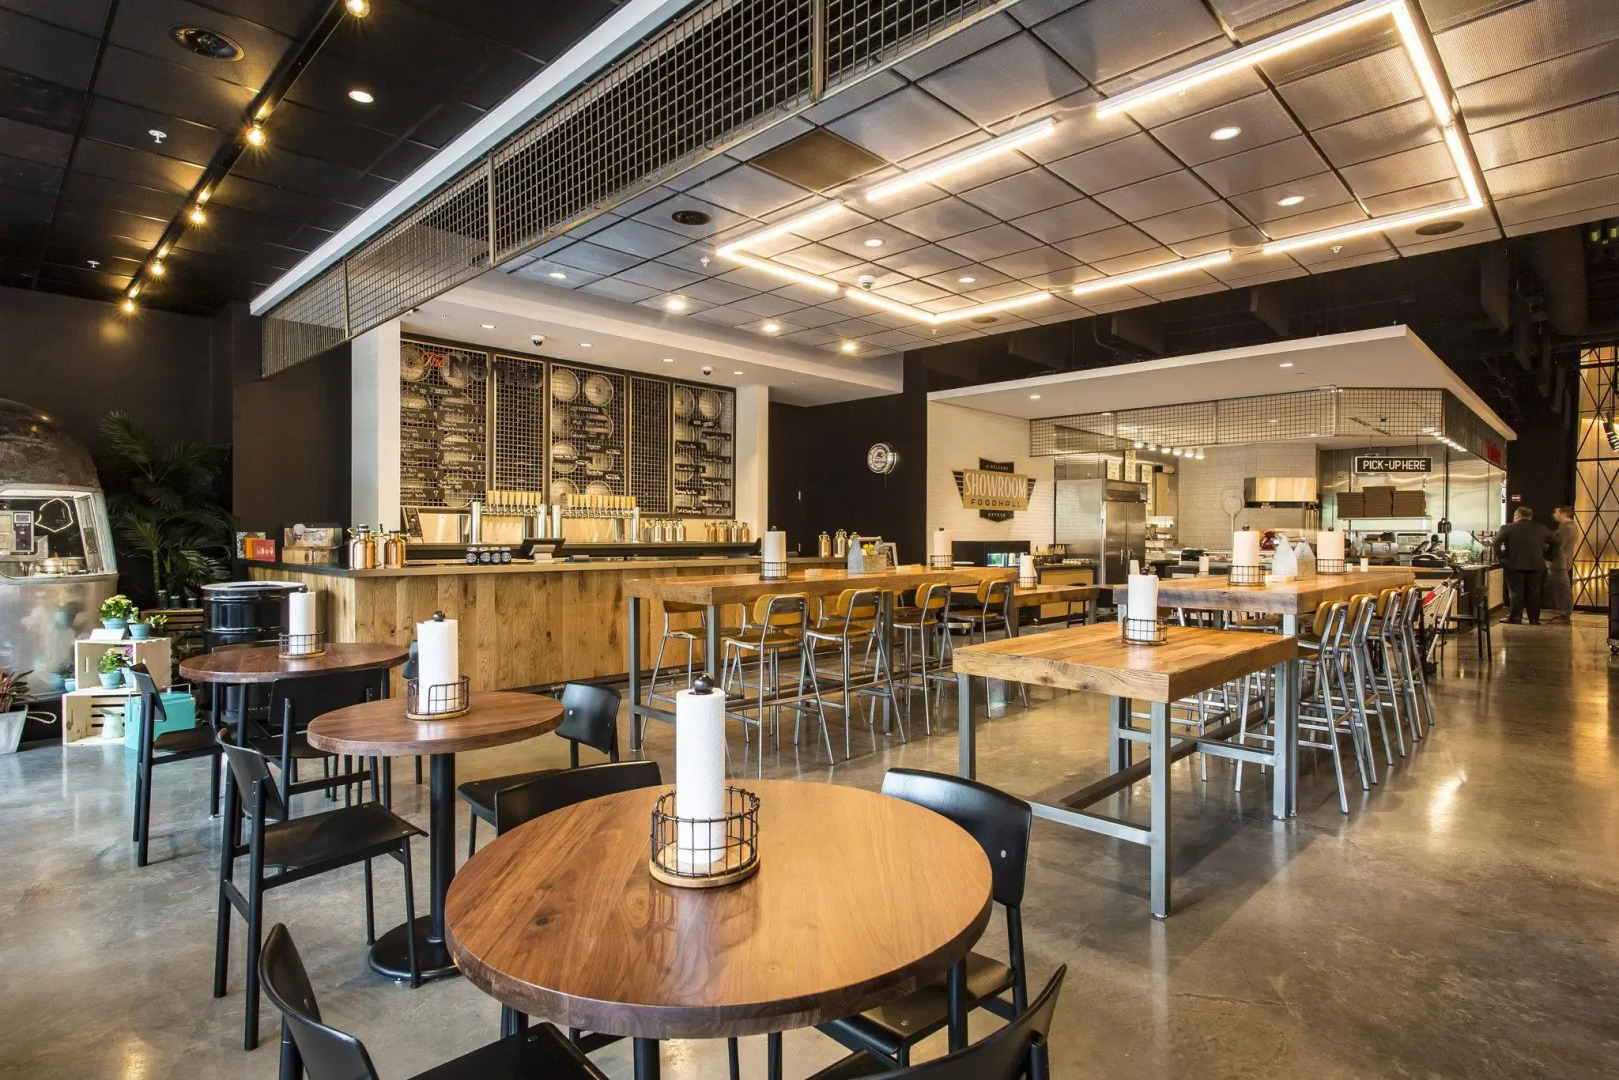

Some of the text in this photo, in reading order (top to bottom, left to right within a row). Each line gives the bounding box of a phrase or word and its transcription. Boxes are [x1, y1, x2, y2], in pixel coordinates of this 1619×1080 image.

[421, 351, 445, 368] The
[1363, 460, 1426, 470] PICK-UP HERE
[965, 473, 1027, 498] SHOWROOM
[970, 499, 1021, 507] FOODHALL
